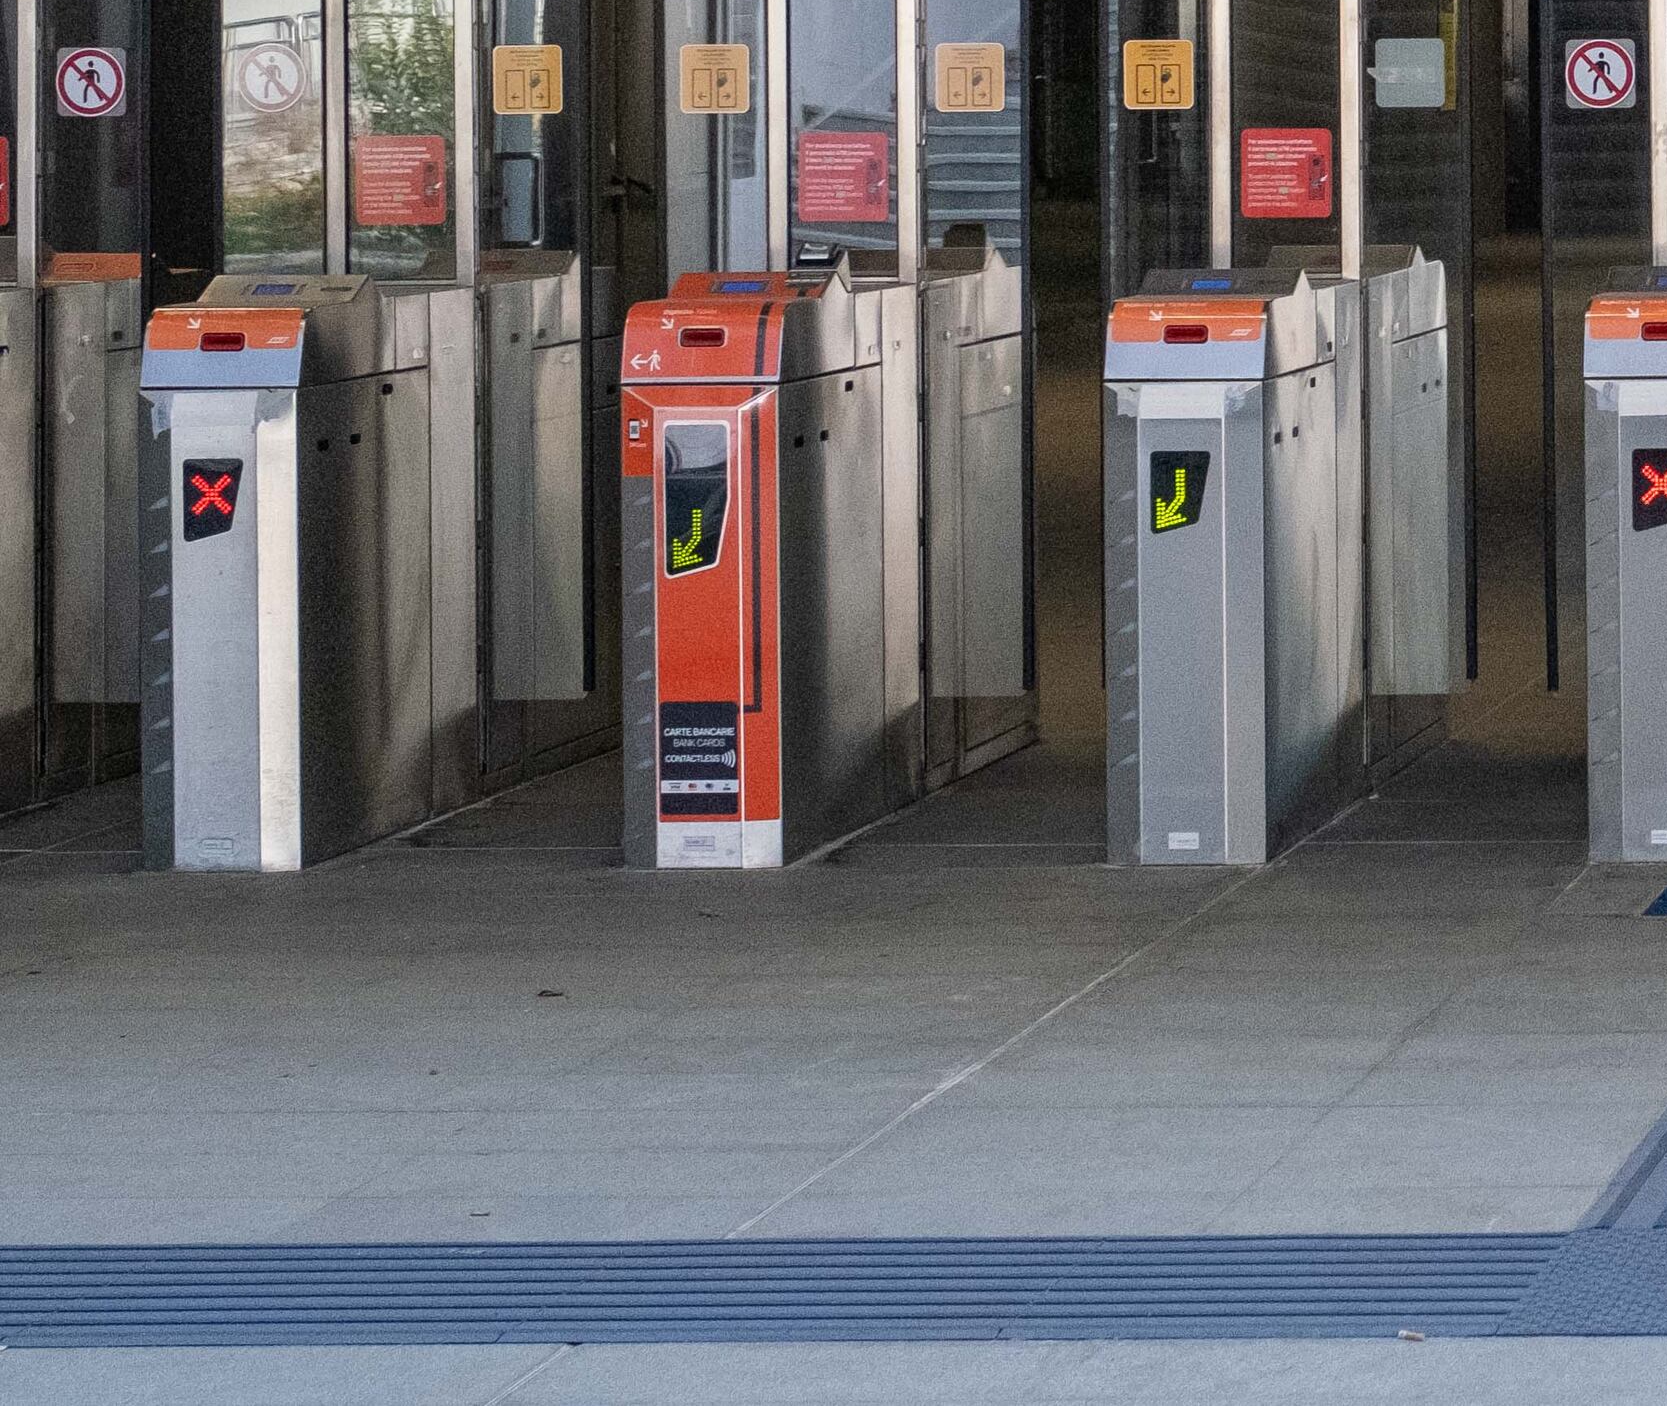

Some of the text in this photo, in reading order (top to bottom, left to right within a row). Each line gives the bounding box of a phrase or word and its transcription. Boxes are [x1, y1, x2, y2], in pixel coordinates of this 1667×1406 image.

[664, 727, 735, 737] CARTE BANCARIE
[673, 738, 726, 748] BANK CARDS
[664, 753, 721, 763] CONTACTLESS
